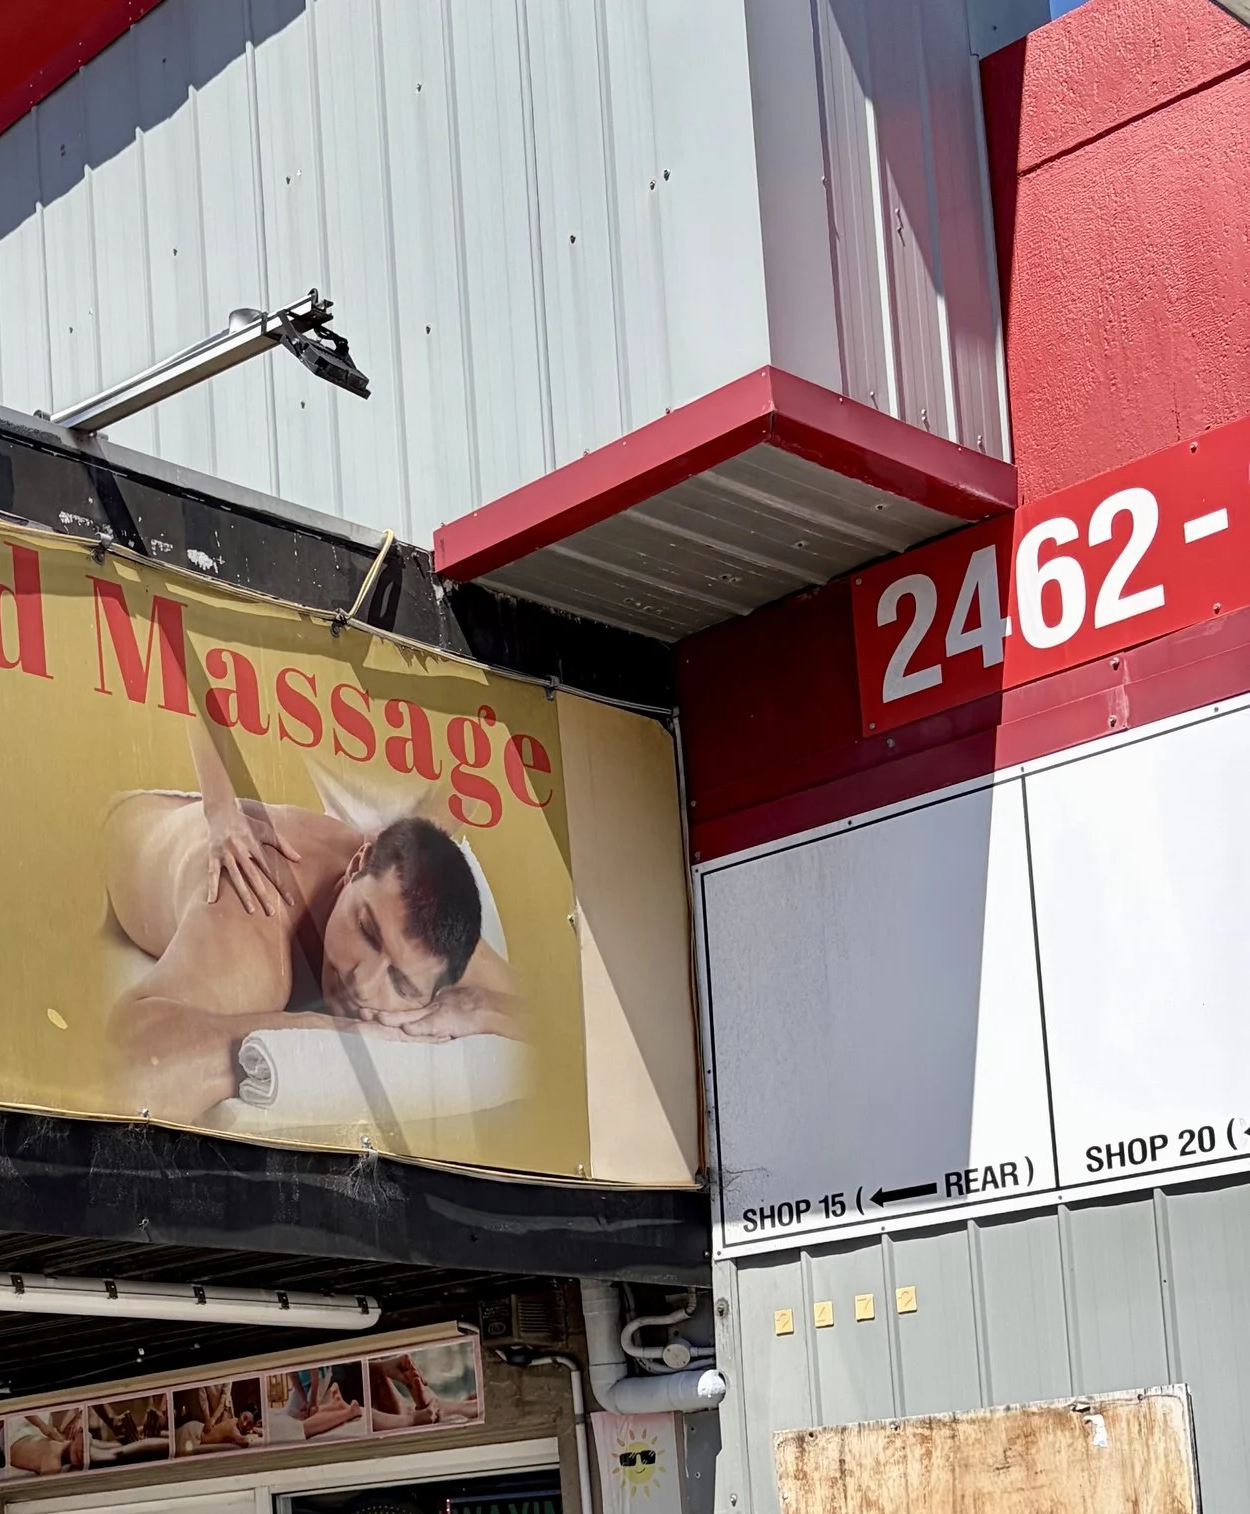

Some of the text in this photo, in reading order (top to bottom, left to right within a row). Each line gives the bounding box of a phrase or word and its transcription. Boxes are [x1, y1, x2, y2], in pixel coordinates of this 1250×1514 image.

[877, 487, 1166, 704] 2462
[86, 574, 554, 829] Massage
[742, 1199, 812, 1233] SHOP
[817, 1192, 847, 1219] 15
[1086, 1134, 1169, 1173] SHOP
[1178, 1125, 1216, 1157] 20
